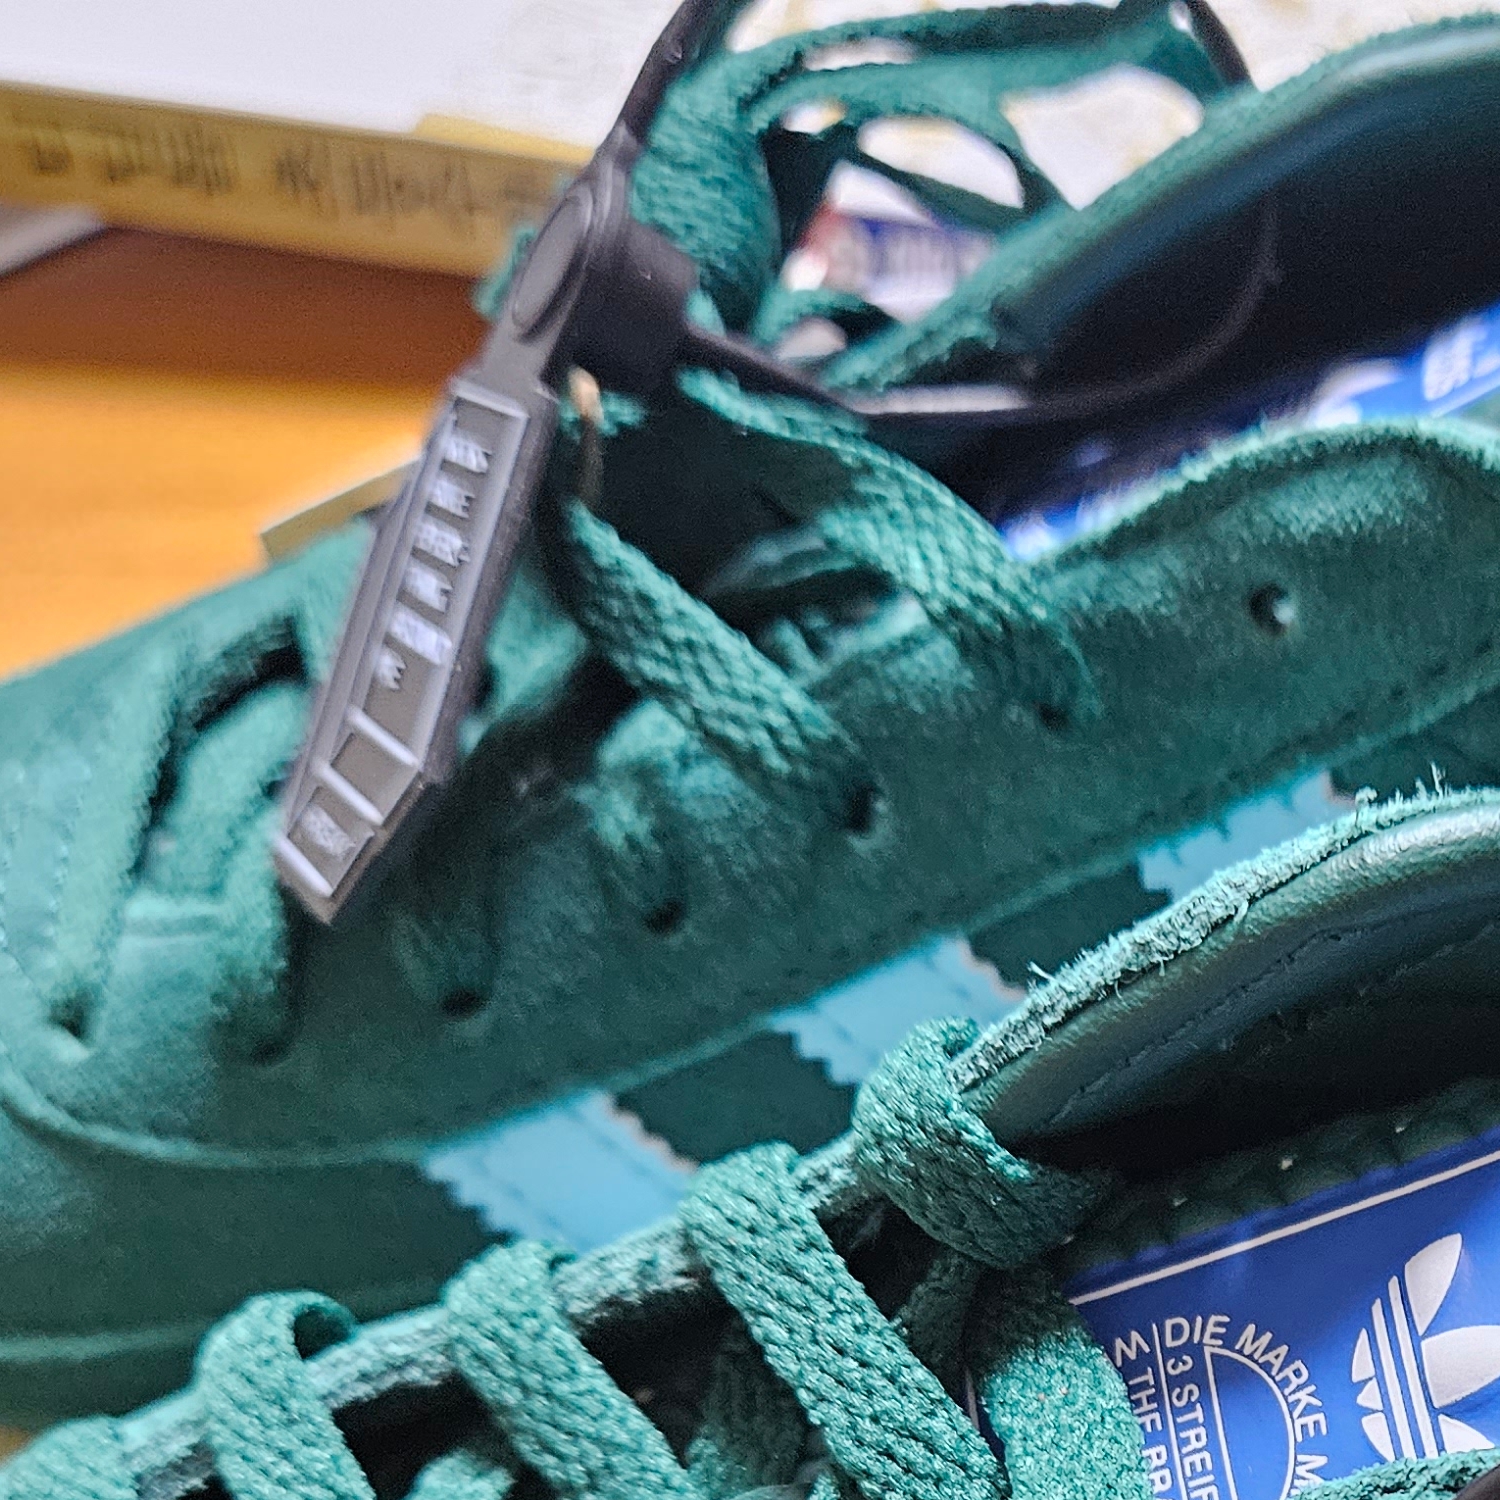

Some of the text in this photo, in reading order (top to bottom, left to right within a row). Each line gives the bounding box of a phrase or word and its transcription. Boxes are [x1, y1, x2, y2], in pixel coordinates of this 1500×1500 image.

[1164, 1314, 1231, 1348] DIE
[1234, 1322, 1329, 1443] MARKE
[1166, 1354, 1193, 1377] 3
